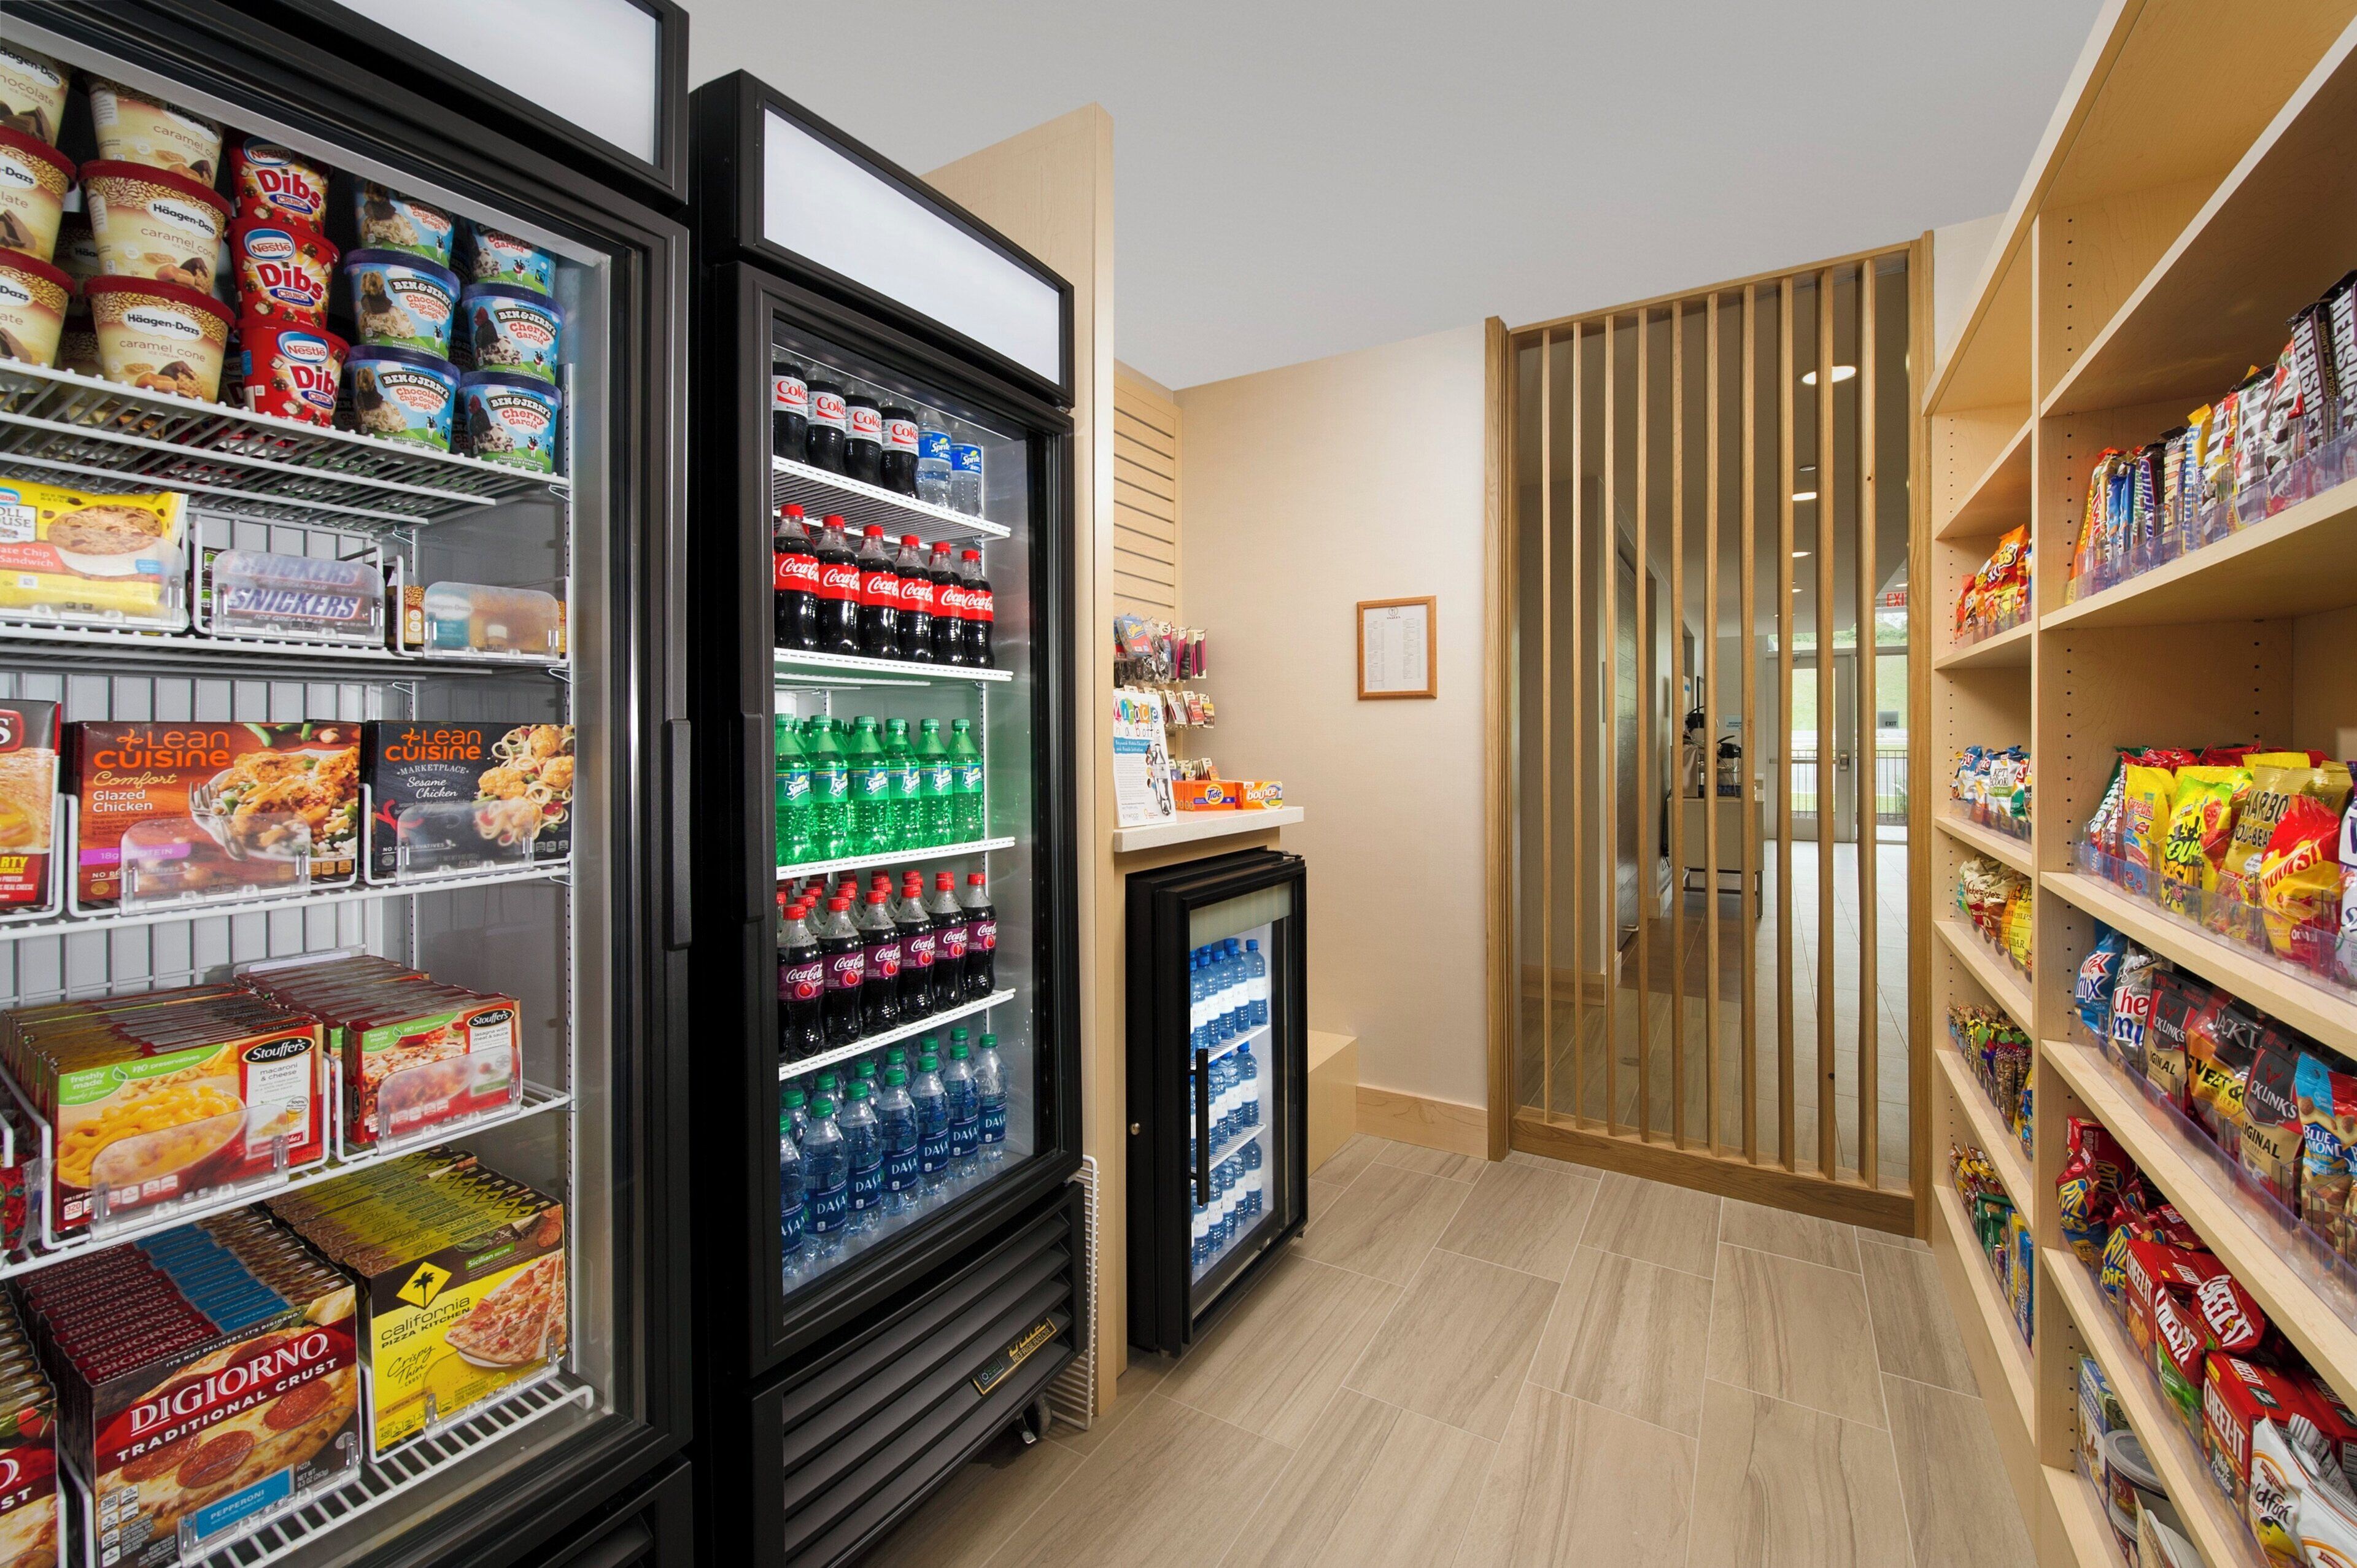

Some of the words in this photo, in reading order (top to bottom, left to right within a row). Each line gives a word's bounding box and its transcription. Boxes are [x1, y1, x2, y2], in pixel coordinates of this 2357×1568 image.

[0, 45, 60, 85] äagen-Dazs
[0, 74, 54, 107] hocolate
[153, 125, 203, 151] caramel
[206, 145, 219, 162] con
[255, 168, 322, 209] Dibs
[153, 203, 215, 235] Häagen-Dazs
[422, 217, 441, 230] Dough
[141, 226, 195, 249] caramel
[198, 244, 217, 261] cone
[494, 242, 524, 253] Garcia
[257, 261, 324, 300] Dibs
[406, 295, 447, 315] Chocolate
[409, 303, 427, 311] Chip
[428, 305, 446, 319] Cookie
[419, 308, 439, 320] Dough
[127, 314, 200, 336] Häagen-Dazs
[509, 322, 551, 342] Cherry
[516, 332, 544, 346] Garcia
[119, 339, 172, 353] caramel
[177, 347, 206, 362] cone
[396, 388, 443, 404] Chocolate
[776, 380, 807, 403] Coke
[411, 401, 432, 410] Dough
[419, 396, 440, 409] Cookie
[816, 396, 846, 414] Coke
[501, 408, 544, 427] Cherry
[509, 418, 538, 430] Garcia
[853, 411, 881, 430] Coke
[892, 423, 918, 440] Coke
[931, 440, 951, 454] Sprit
[962, 455, 981, 466] Sprit
[3, 517, 31, 528] USE
[23, 548, 50, 558] Chip
[228, 587, 359, 617] SNICKERS
[1886, 592, 1906, 608] EXI
[400, 764, 466, 776] MARKETPLACE
[93, 771, 177, 788] Comfort
[407, 776, 447, 787] Sesame
[786, 780, 809, 796] Sprit
[867, 776, 889, 792] Sprit
[93, 790, 145, 801] Glazed
[416, 787, 458, 798] Chicken
[1207, 788, 1222, 800] Tide
[1247, 786, 1278, 801] bounce
[93, 801, 153, 813] Chicken
[2113, 986, 2149, 1015] Che
[473, 1011, 509, 1025] Stouffer's
[369, 1030, 389, 1038] freshly
[474, 1028, 495, 1037] lasagna
[2112, 1016, 2143, 1046] mi
[2162, 1019, 2186, 1043] LINK'S
[2212, 1008, 2247, 1048] JACK
[251, 1038, 306, 1060] Stouffer's
[132, 1064, 149, 1073] no
[150, 1054, 200, 1069] preservatives
[260, 1062, 298, 1075] macaroni
[2150, 1051, 2175, 1075] IGINAL
[71, 1072, 105, 1084] freshly
[268, 1070, 297, 1080] cheese
[2261, 1085, 2297, 1119] LINK'S
[985, 1113, 1005, 1129] DASA
[953, 1124, 979, 1141] DASA
[2242, 1121, 2280, 1159] IGINAL
[2303, 1124, 2332, 1144] BLUE
[925, 1140, 948, 1157] DASA
[892, 1157, 917, 1175] DASA
[856, 1174, 881, 1192] DASA
[66, 1203, 81, 1213] 320
[818, 1194, 847, 1214] DASA
[468, 1254, 493, 1268] Sicilian
[2127, 1249, 2153, 1307] CHEEZ-IT
[381, 1296, 470, 1341] california
[381, 1330, 416, 1349] PIZZA
[421, 1309, 470, 1331] KITCHEN
[87, 1319, 191, 1363] DIGIORNO
[166, 1359, 180, 1367] IT'S
[184, 1351, 200, 1361] NOT
[245, 1327, 258, 1337] IT'S
[1012, 1327, 1051, 1363] REFRIGERATOR
[97, 1330, 203, 1375] DIGIORNO
[387, 1345, 436, 1378] Crispy
[395, 1364, 427, 1384] Thin
[405, 1374, 422, 1387] CRUST
[117, 1392, 266, 1462] TRADITIONAL
[276, 1358, 337, 1392] CRUST
[2204, 1377, 2245, 1464] CHEEZ-IT
[297, 1461, 311, 1470] PIZZA
[297, 1472, 307, 1481] NET
[211, 1489, 265, 1520] PEPPERONI
